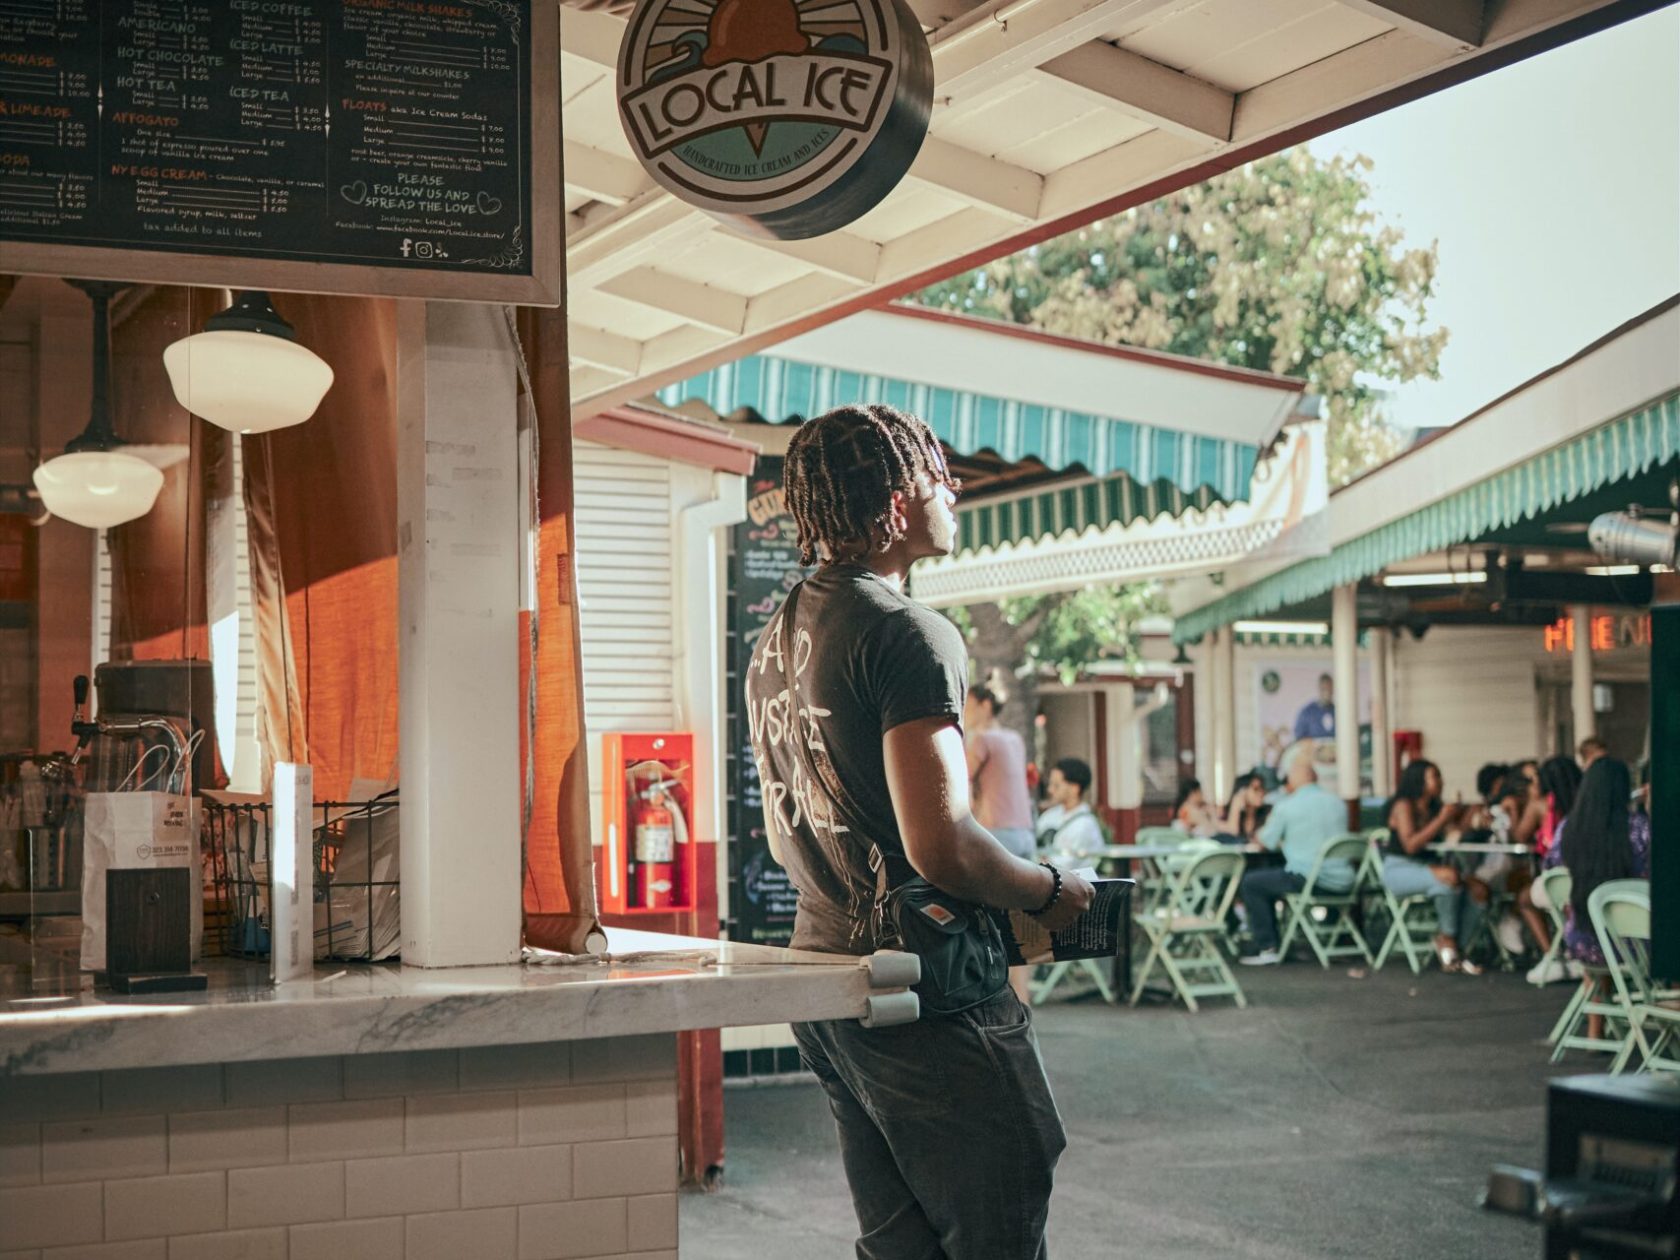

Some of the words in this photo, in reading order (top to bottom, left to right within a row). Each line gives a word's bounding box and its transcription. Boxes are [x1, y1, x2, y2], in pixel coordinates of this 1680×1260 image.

[230, 0, 259, 10] ICED
[262, 3, 313, 17] COFFEE
[428, 4, 473, 17] SHAKES
[118, 16, 196, 33] AMERICANO
[230, 38, 259, 50] ICED
[262, 42, 304, 55] LATTE
[117, 47, 144, 59] HOT
[147, 50, 224, 66] CHOCOLATE
[344, 59, 401, 73] SPECIALTY
[117, 76, 144, 88] HOT
[148, 79, 176, 92] TEA
[229, 85, 259, 98] ICED
[262, 90, 289, 102] TEA
[342, 98, 387, 111] FLOATS
[412, 107, 426, 116] Ice
[429, 108, 458, 118] Cream
[461, 111, 487, 121] Sodas
[638, 62, 785, 142] LOCAL
[803, 62, 871, 117] ICE
[11, 103, 73, 118] LIMEADE
[363, 113, 384, 122] Small
[112, 112, 179, 126] AFFOGATO
[241, 118, 263, 128] Large
[363, 126, 394, 135] Medium
[363, 136, 385, 146] Large
[200, 145, 229, 156] poured
[683, 145, 741, 175] HANDCRAFTED
[744, 164, 757, 176] ICE
[761, 156, 792, 173] CREAM
[794, 144, 811, 161] AND
[811, 128, 830, 147] ICES
[111, 164, 128, 175] NY
[130, 166, 159, 178] EGG
[160, 167, 208, 180] CREAM
[398, 172, 445, 186] PLEASE
[136, 187, 169, 196] Medium
[373, 184, 424, 197] FOLLOW
[427, 189, 442, 199] US
[445, 190, 470, 201] AND
[136, 196, 159, 205] Large
[365, 197, 415, 210] SPREAD
[418, 201, 443, 212] THE
[445, 202, 477, 214] LOVE
[137, 205, 175, 215] Flavored
[143, 221, 160, 230] tax
[164, 222, 198, 233] added
[216, 226, 230, 236] all
[235, 228, 262, 238] items
[750, 613, 813, 678] ...AD
[792, 755, 850, 838] ALL
